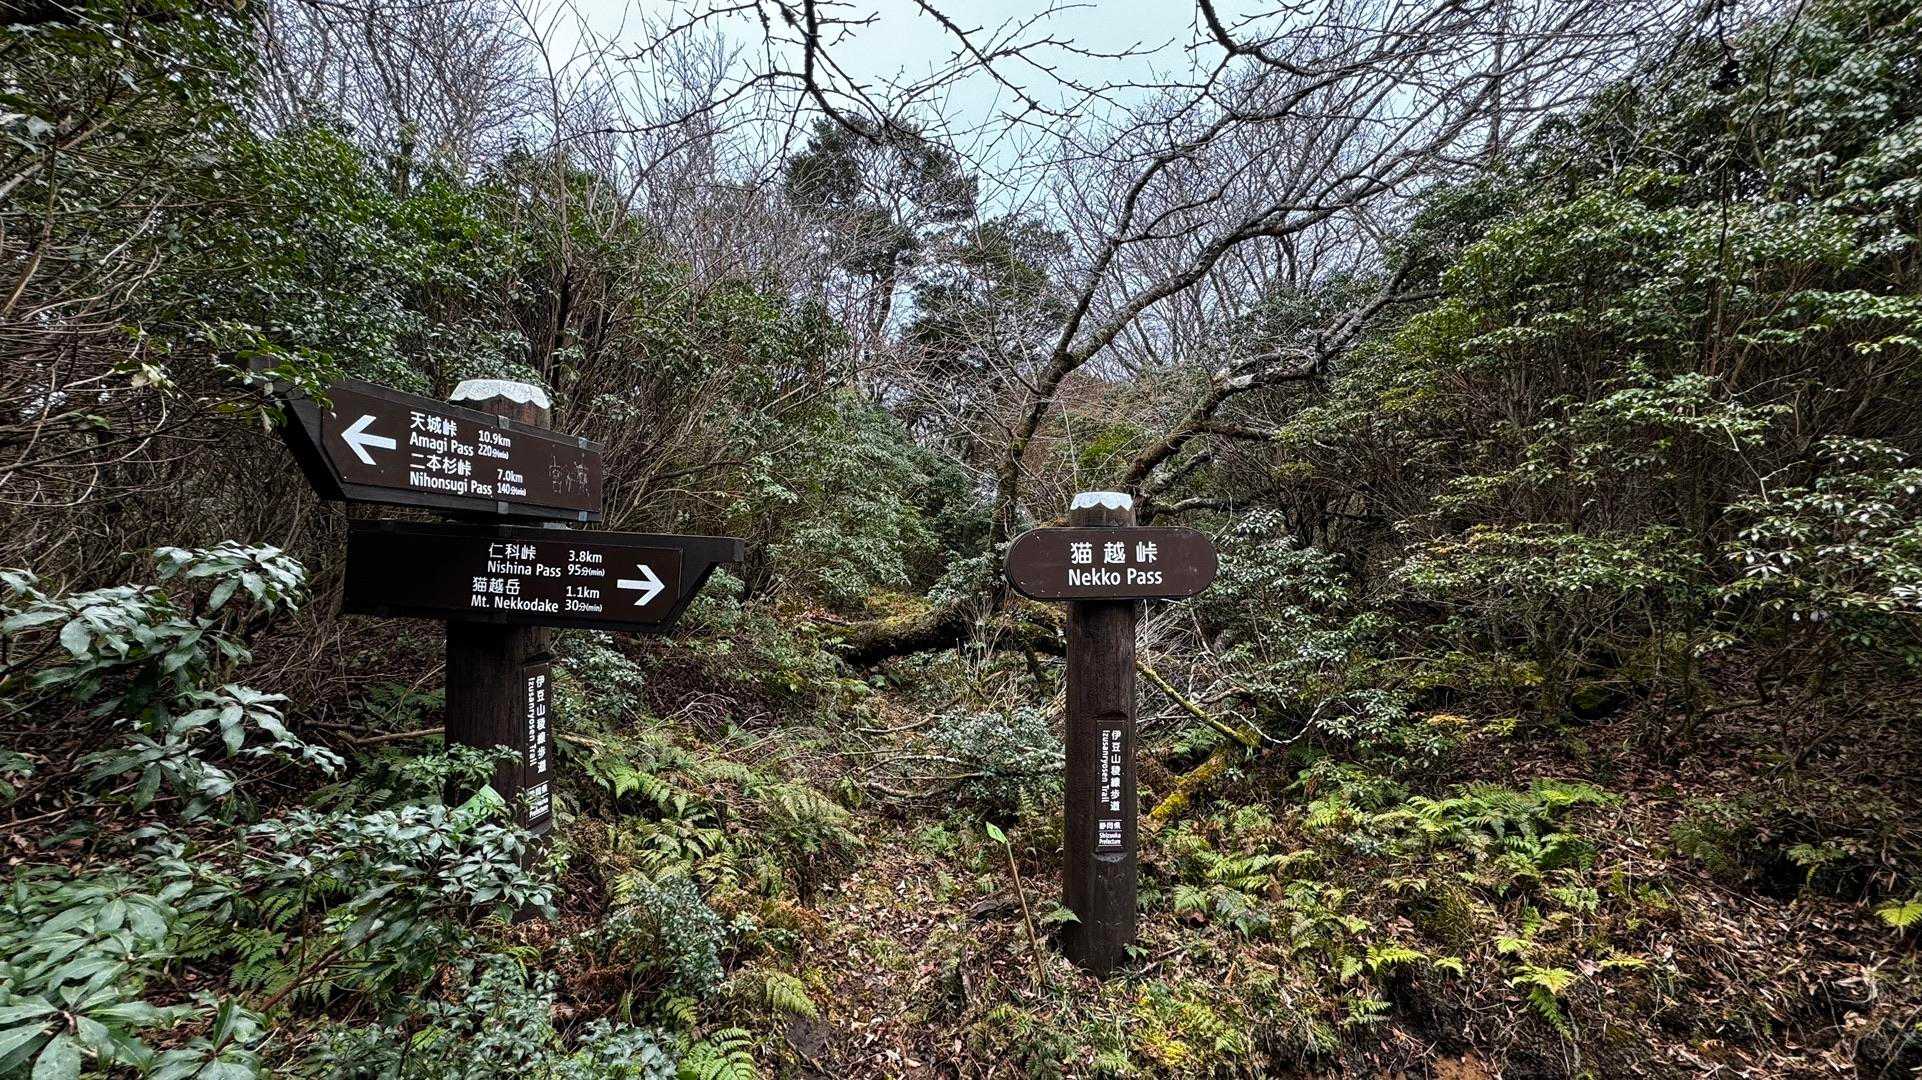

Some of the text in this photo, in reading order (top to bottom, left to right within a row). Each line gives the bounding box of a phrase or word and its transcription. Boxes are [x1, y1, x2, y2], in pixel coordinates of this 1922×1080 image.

[410, 411, 458, 437] 天城峠
[410, 432, 474, 457] Amagi Pass
[478, 430, 511, 448] 10.9km
[410, 452, 472, 476] 二本杉峠
[410, 471, 493, 496] Nihonsugi Pass
[497, 469, 523, 484] 7.0km
[488, 543, 536, 561] 仁科峠
[568, 550, 603, 563] 3.8km
[1070, 541, 1158, 564] 猫越峠
[487, 561, 561, 578] Nishina Pass
[1068, 567, 1163, 586] Nekko Pass
[472, 576, 521, 596] 猫越岳
[566, 585, 600, 599] 1.1km
[471, 595, 559, 613] Mt. Nekkodake
[529, 743, 537, 767] Trail
[1101, 785, 1110, 803] Trail
